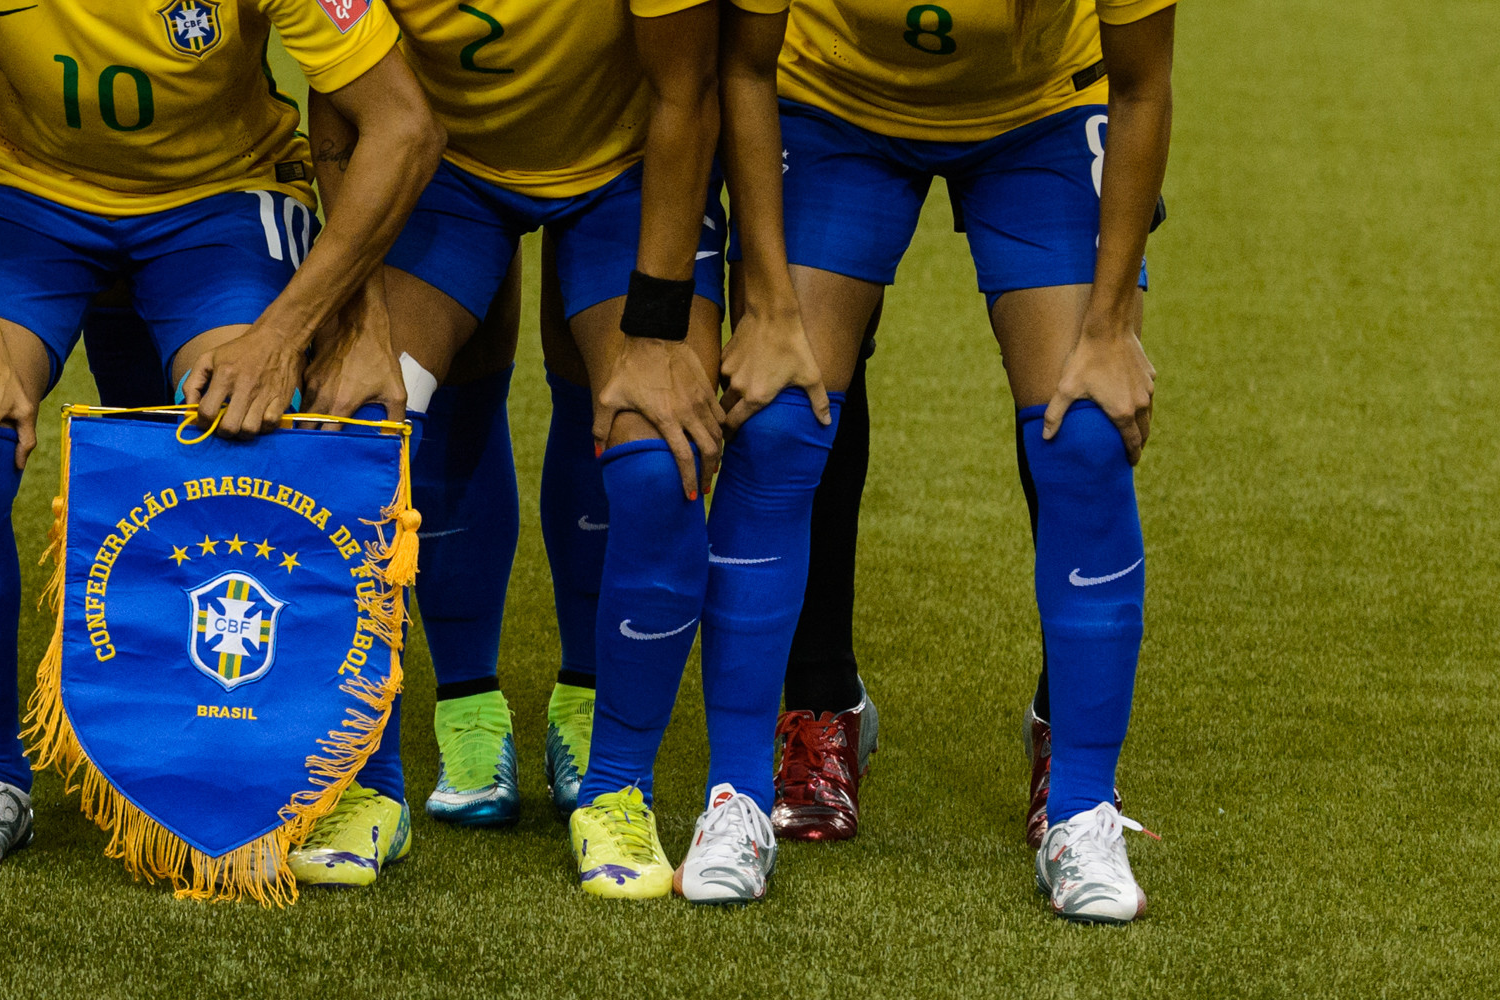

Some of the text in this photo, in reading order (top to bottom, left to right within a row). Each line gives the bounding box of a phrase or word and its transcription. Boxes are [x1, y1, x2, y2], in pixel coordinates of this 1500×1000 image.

[183, 20, 202, 29] CBF
[457, 3, 515, 74] 2
[903, 4, 957, 55] 8
[53, 53, 156, 131] 10
[245, 190, 310, 271] 10
[85, 487, 178, 663] CONFEDERAÇÃO
[183, 476, 332, 531] BRASILEIRA
[329, 525, 362, 560] DE
[214, 617, 251, 634] CBF
[197, 704, 258, 720] BRASIL
